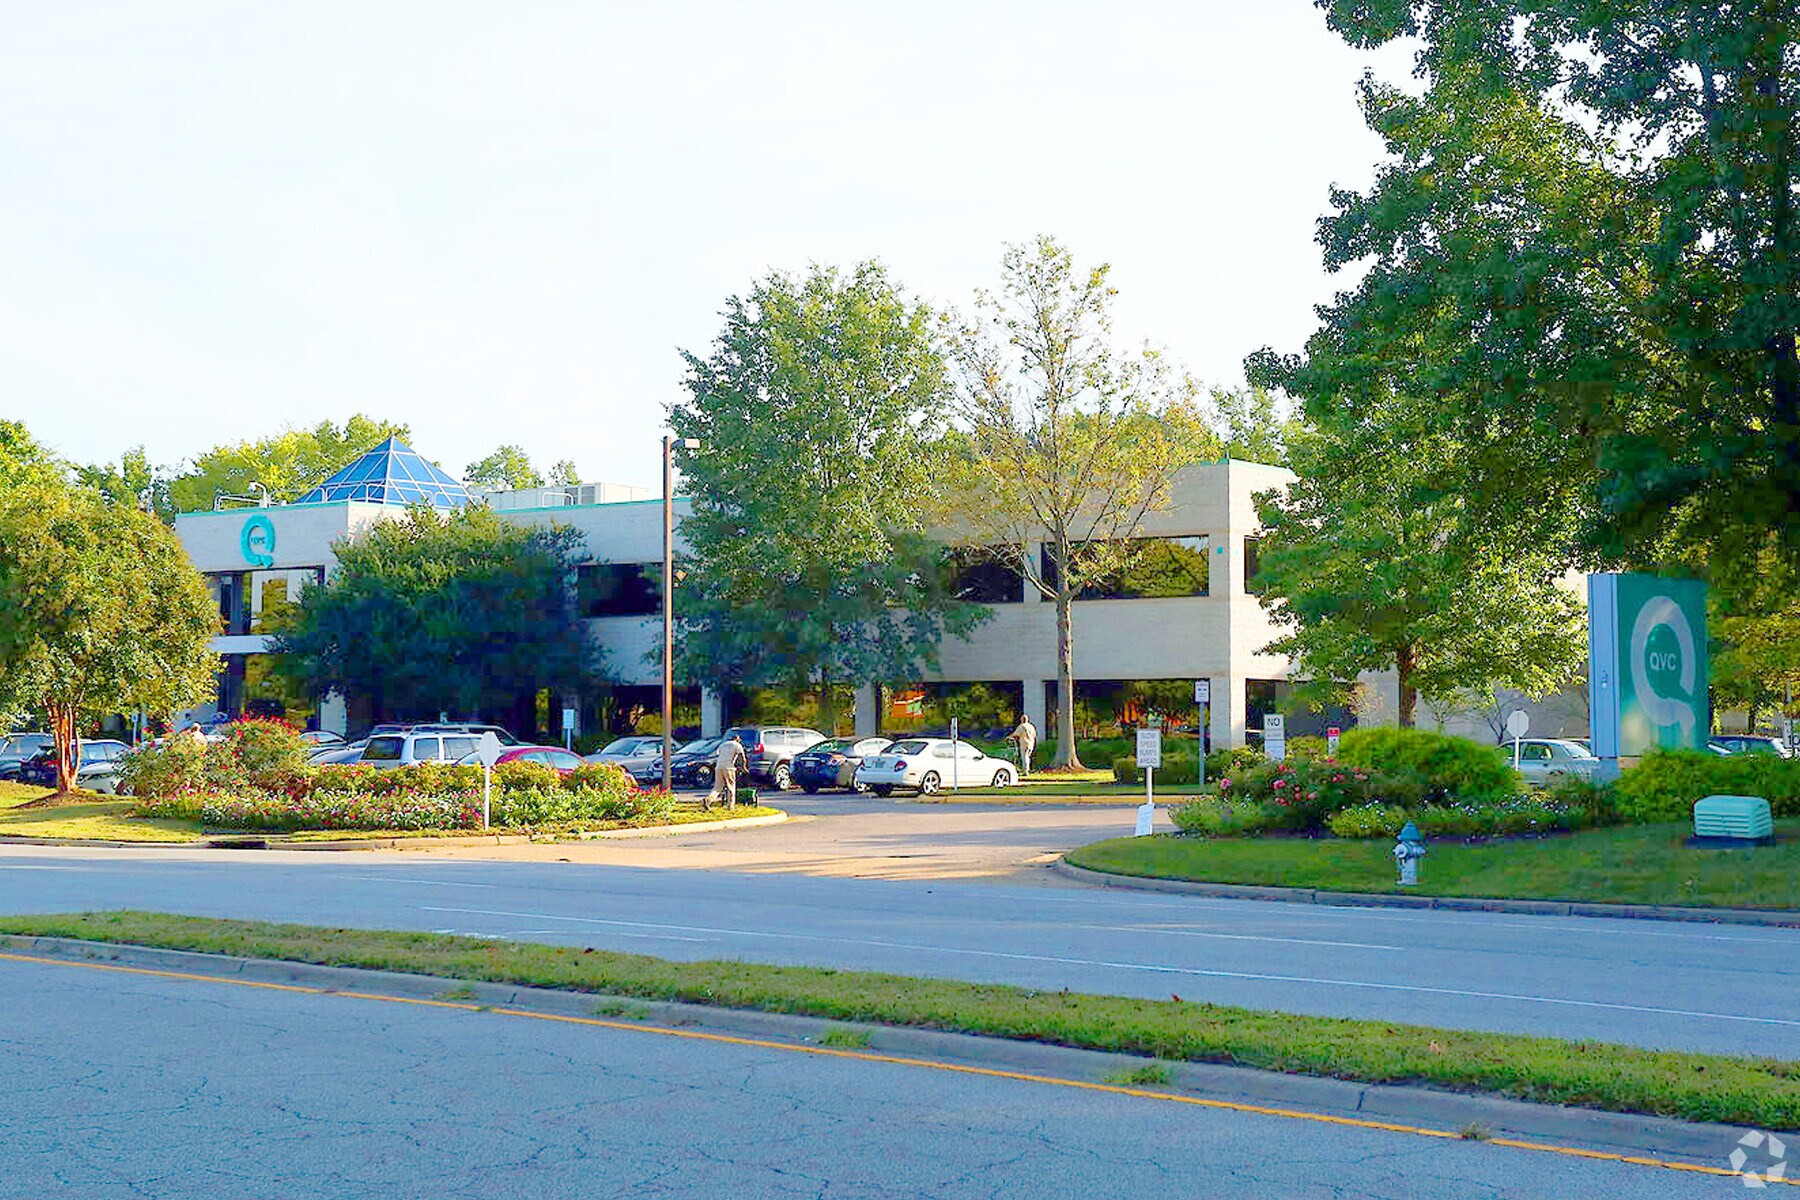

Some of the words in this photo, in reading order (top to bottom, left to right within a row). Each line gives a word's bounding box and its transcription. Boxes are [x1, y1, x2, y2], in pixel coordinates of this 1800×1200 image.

[1649, 652, 1677, 671] QVC
[1267, 717, 1280, 726] NO
[1140, 740, 1157, 748] SPEED
